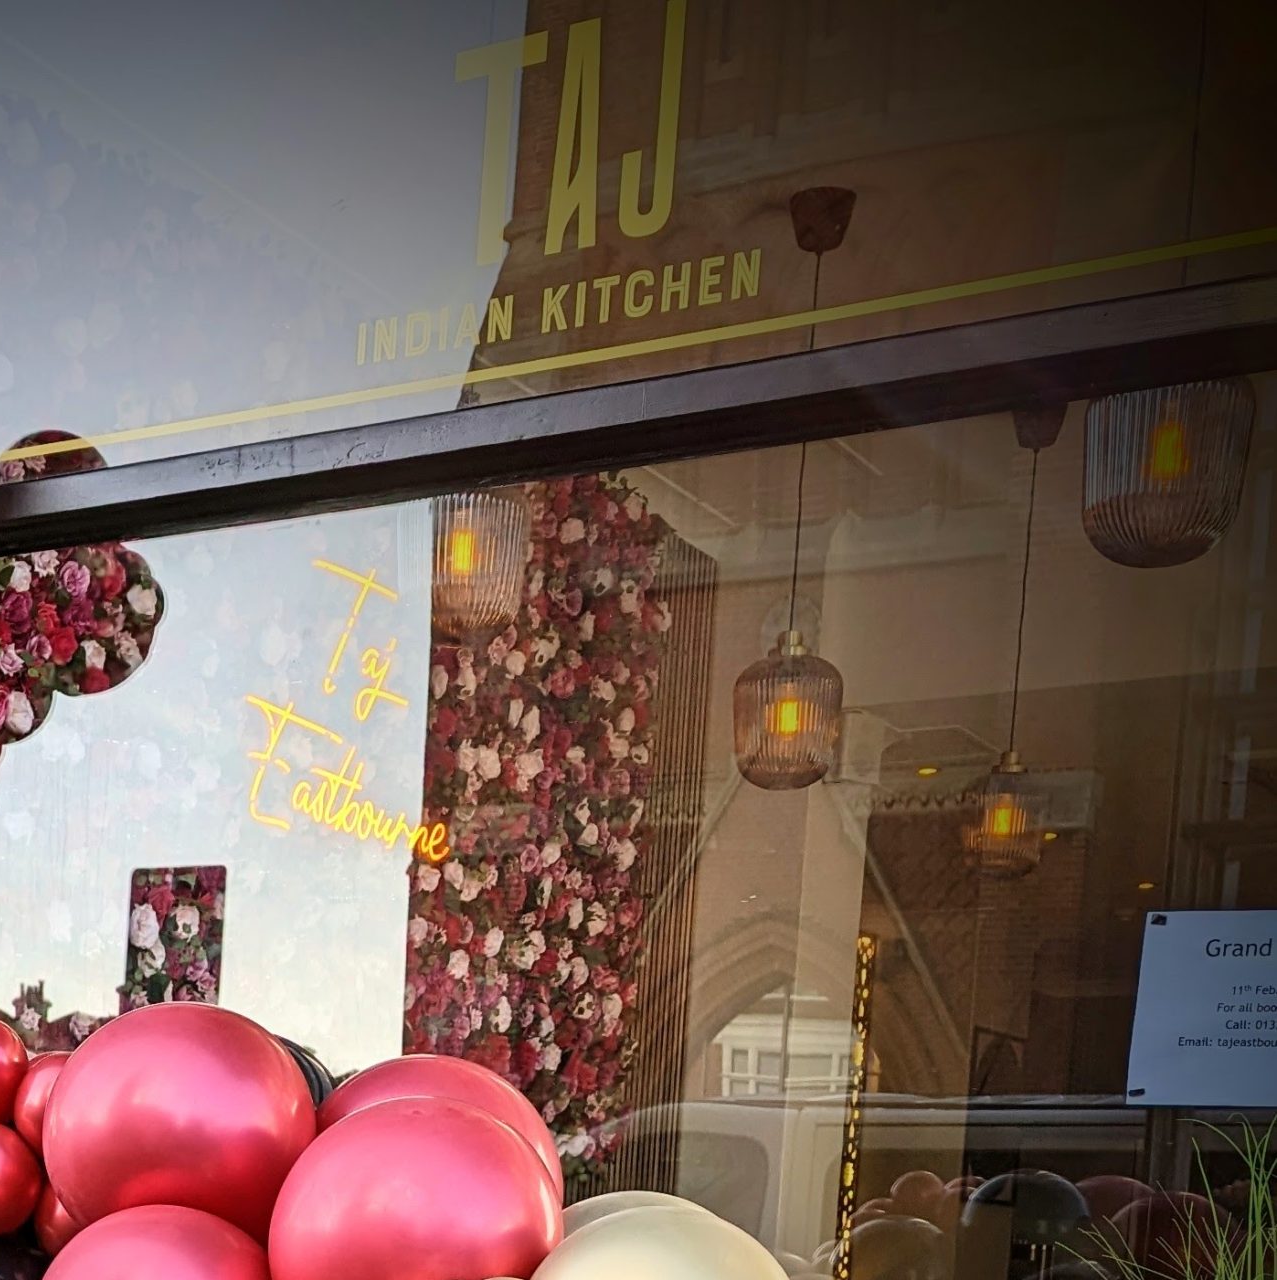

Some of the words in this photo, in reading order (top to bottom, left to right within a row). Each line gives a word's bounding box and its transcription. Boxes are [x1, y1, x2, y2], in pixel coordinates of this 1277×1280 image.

[455, 0, 687, 267] TAJ
[356, 294, 514, 366] INDIAN
[541, 248, 762, 334] KITCHEN
[311, 559, 409, 721] Taj
[244, 694, 451, 861] Eastbourne
[1205, 938, 1273, 957] Grand
[1232, 985, 1252, 995] 11th
[1217, 1002, 1236, 1013] For
[1238, 1002, 1253, 1013] all
[1225, 1019, 1252, 1030] Call:
[1255, 1020, 1277, 1030] 013
[1178, 1036, 1213, 1047] Email:
